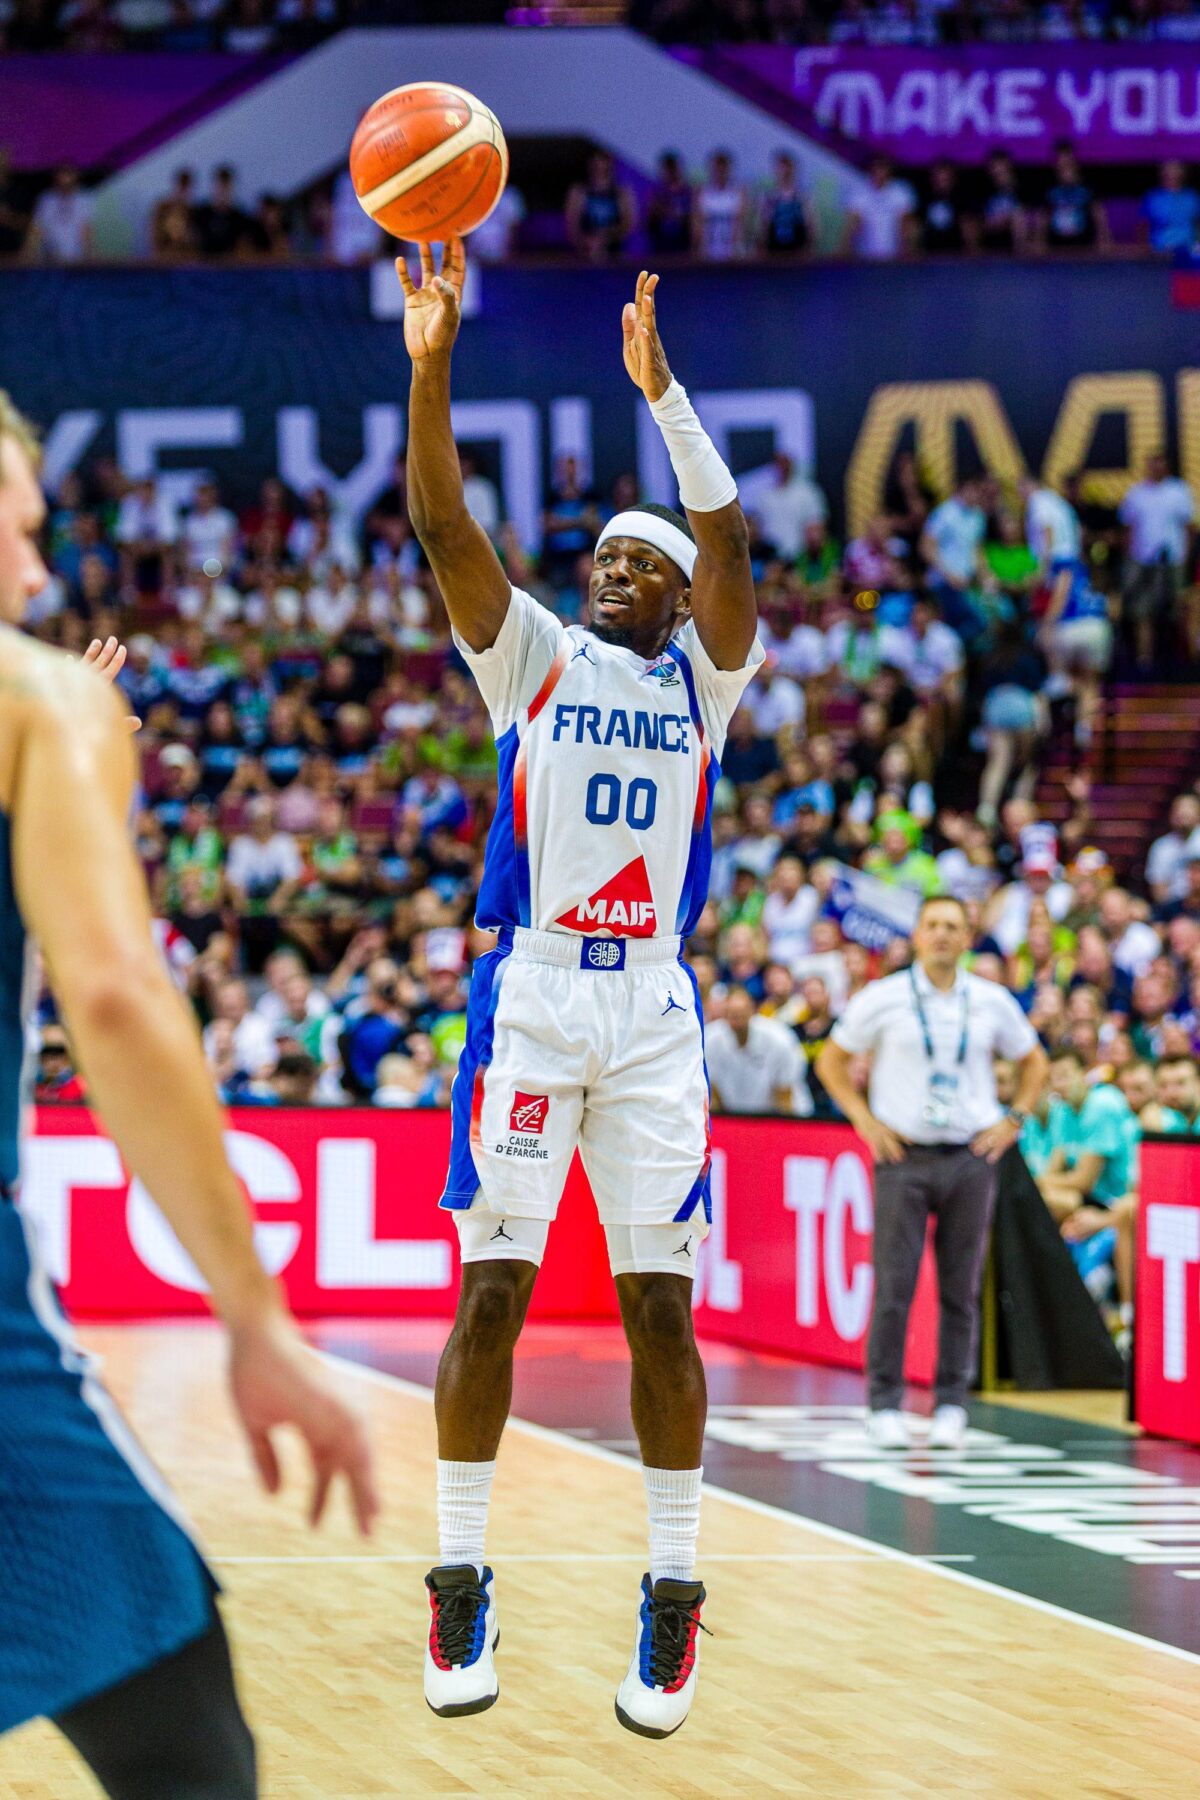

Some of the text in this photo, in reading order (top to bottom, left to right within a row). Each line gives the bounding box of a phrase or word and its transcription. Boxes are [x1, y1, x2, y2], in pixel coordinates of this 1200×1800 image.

[814, 69, 1200, 137] MAKE YOU
[552, 703, 690, 754] FRANCE
[585, 773, 657, 831] 00
[576, 899, 656, 926] MAIF
[509, 1136, 539, 1148] CAISSE
[22, 1130, 452, 1294] TCL
[783, 1151, 875, 1341] TC
